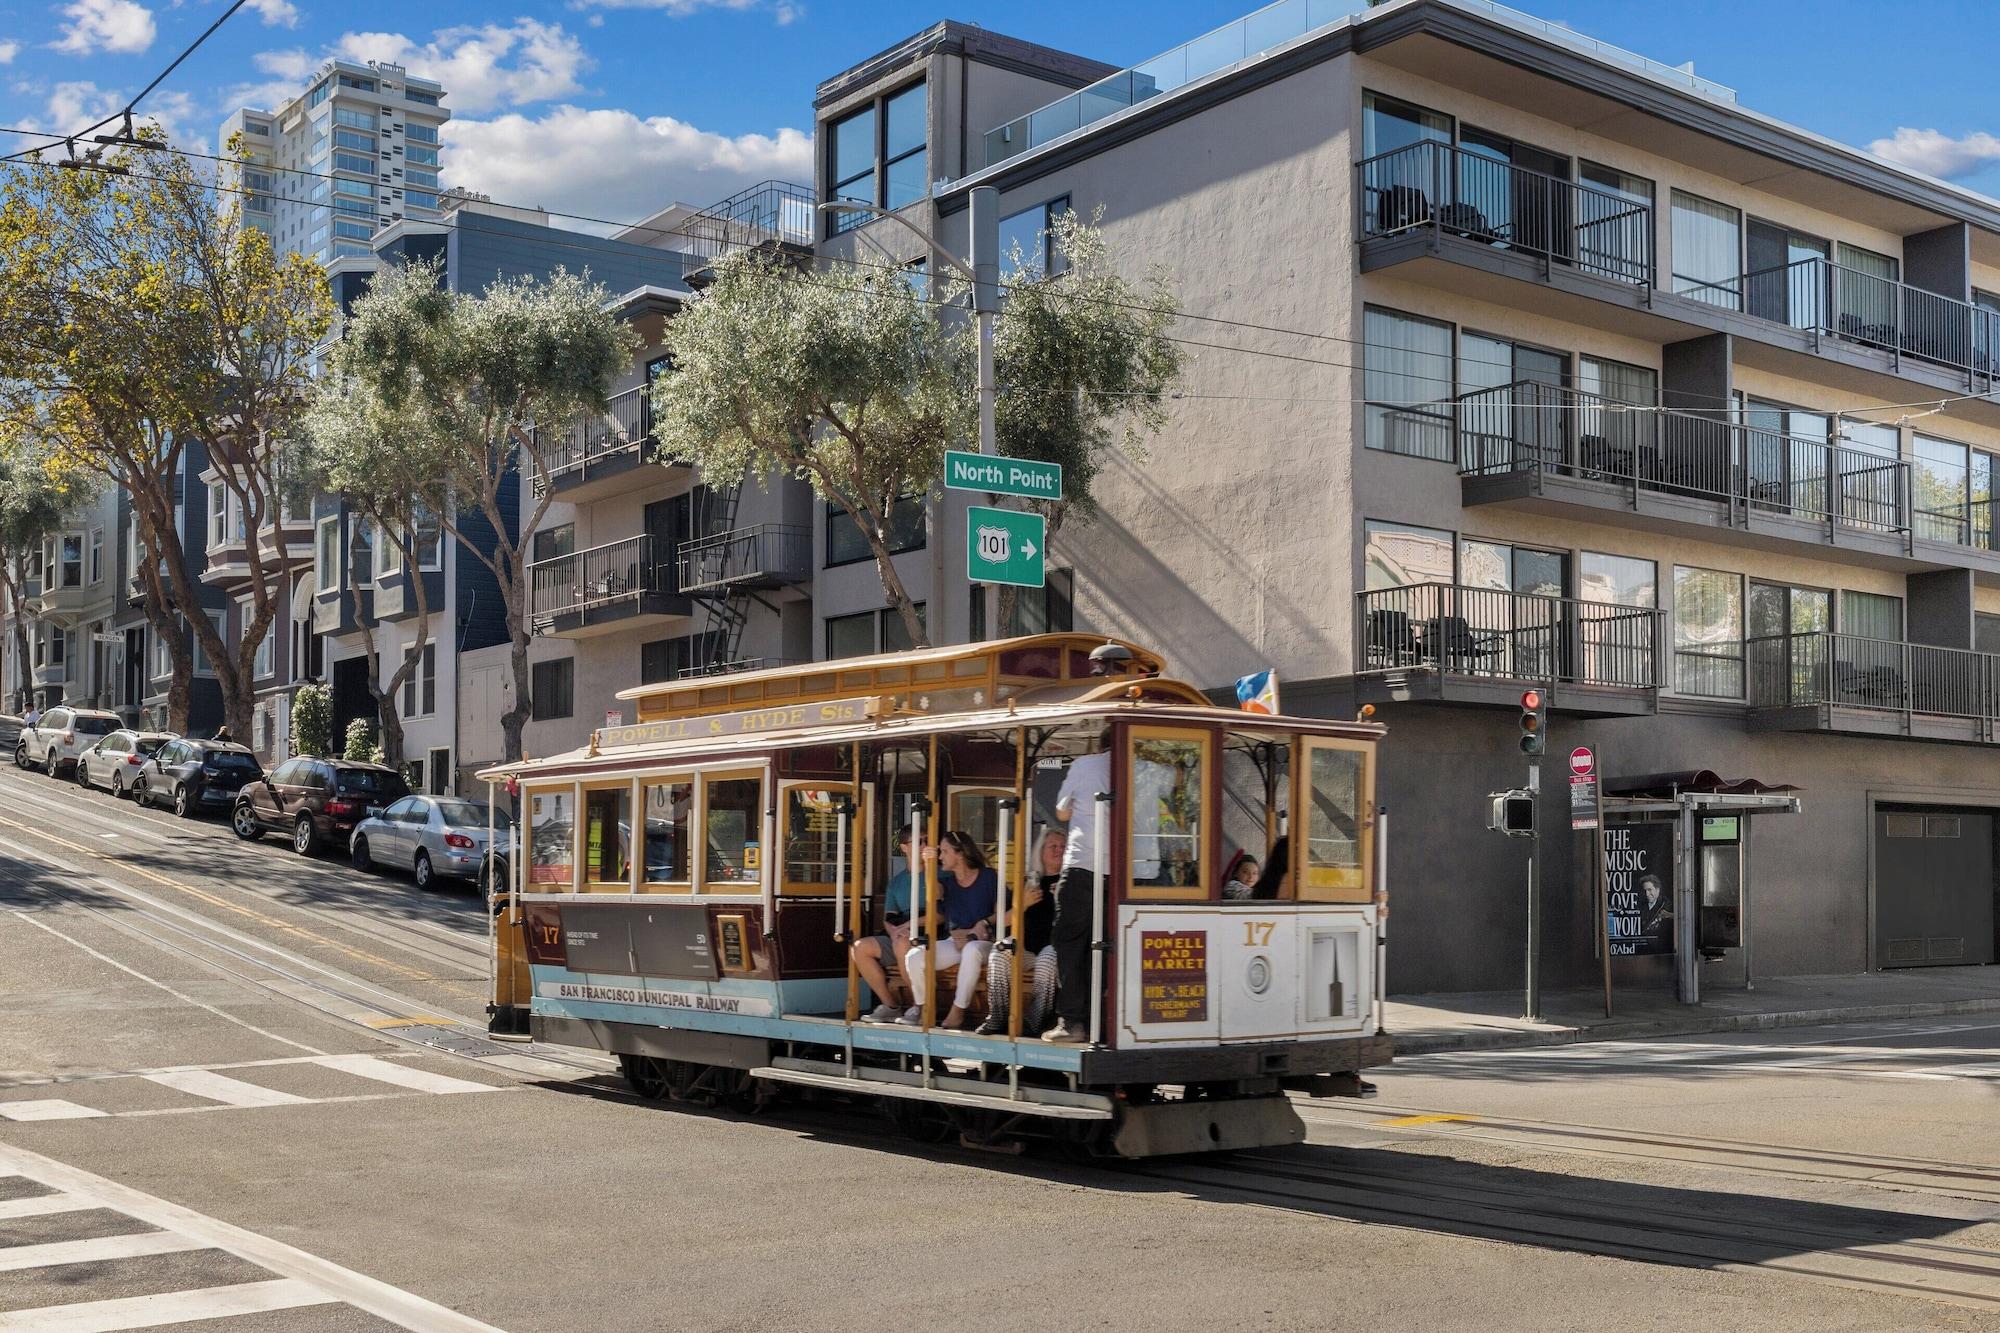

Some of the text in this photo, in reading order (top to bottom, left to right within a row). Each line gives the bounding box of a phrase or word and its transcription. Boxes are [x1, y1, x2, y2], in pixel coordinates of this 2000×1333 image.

[954, 461, 1052, 489] North Point
[982, 535, 1006, 554] 101
[607, 704, 857, 744] POWELL & HYDE Sts.
[1604, 829, 1631, 850] THE
[1605, 850, 1647, 871] MUSIC
[1605, 871, 1632, 892] YOU
[543, 926, 559, 945] 17
[1144, 938, 1204, 949] POWELL
[1243, 922, 1276, 946] 17
[1143, 958, 1205, 969] MARKET
[1160, 949, 1190, 958] AND
[560, 984, 740, 1012] SAN FRANCISCO MUNICIPAL RAILWAY
